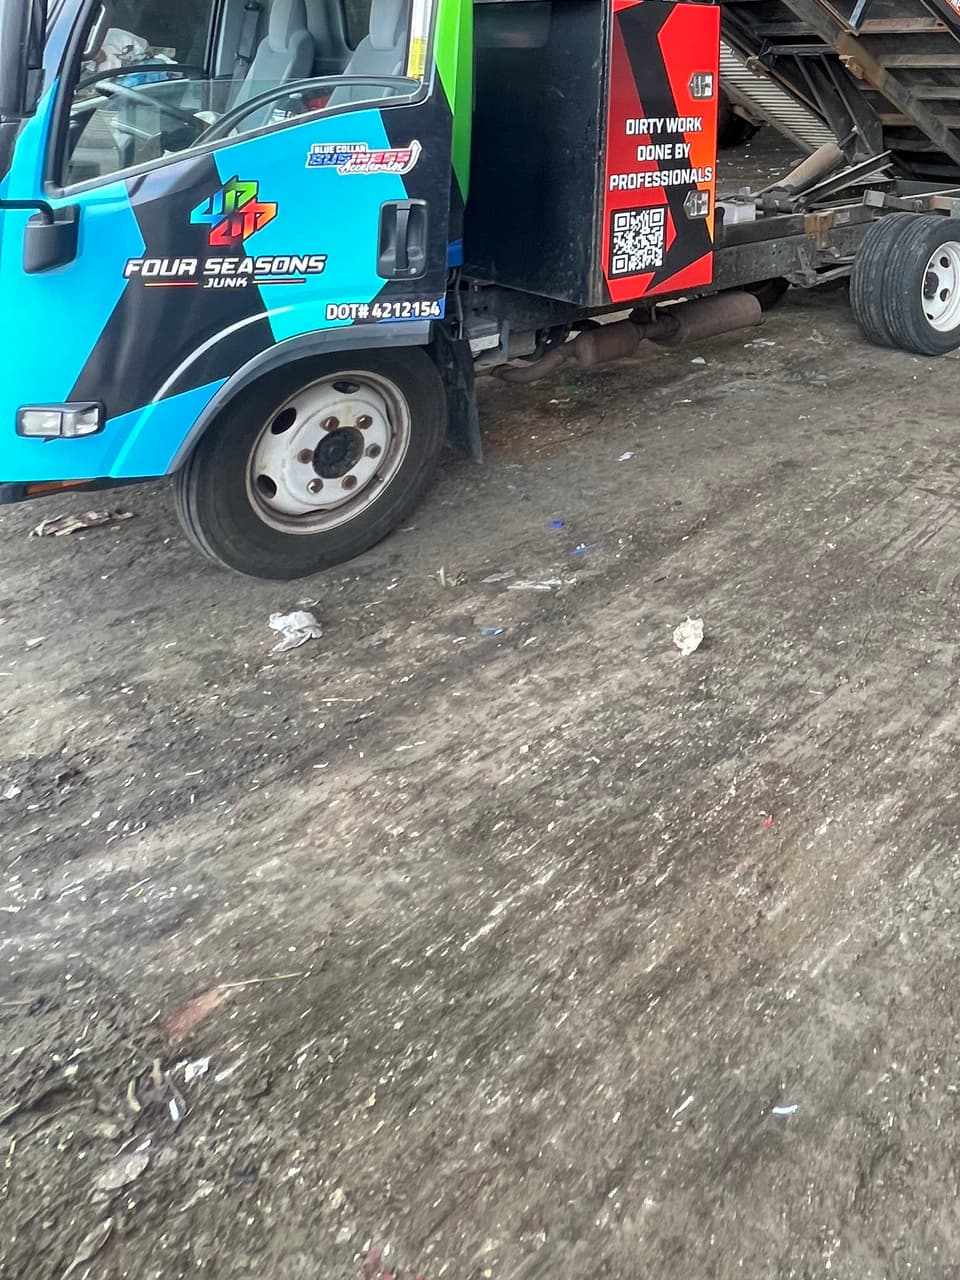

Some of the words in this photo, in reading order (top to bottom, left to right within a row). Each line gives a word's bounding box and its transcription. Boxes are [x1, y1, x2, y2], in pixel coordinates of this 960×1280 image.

[625, 118, 664, 135] DIRTY
[666, 117, 702, 133] WORK
[314, 145, 335, 154] BLUE
[336, 144, 366, 153] COLLAR
[637, 143, 673, 161] DONE
[675, 143, 691, 159] BY
[308, 151, 411, 166] BUSINESS
[609, 167, 713, 191] PROFESSIONALS
[124, 258, 198, 277] FOUR
[203, 256, 327, 275] SEASONS
[203, 277, 248, 288] JUNK
[326, 304, 369, 319] DOT#
[372, 301, 440, 318] 4212154
